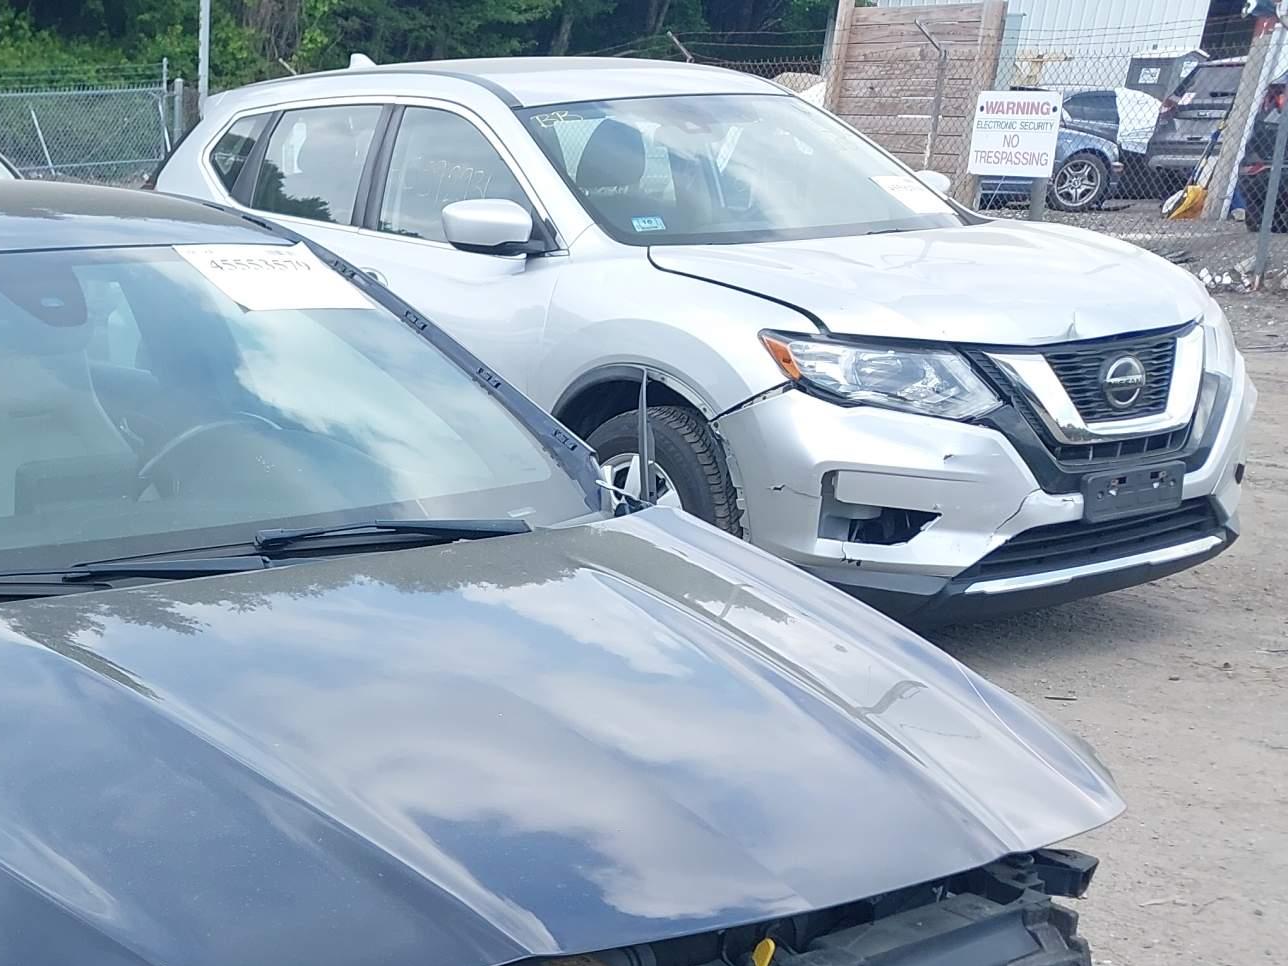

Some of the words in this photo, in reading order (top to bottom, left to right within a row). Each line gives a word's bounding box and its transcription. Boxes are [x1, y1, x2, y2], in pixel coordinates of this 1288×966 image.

[985, 101, 1051, 115] WARNING
[976, 120, 1018, 129] ELECTRONIC
[1019, 121, 1055, 131] SECURITY
[1002, 134, 1020, 148] NO
[974, 150, 1049, 166] TRESPASSING
